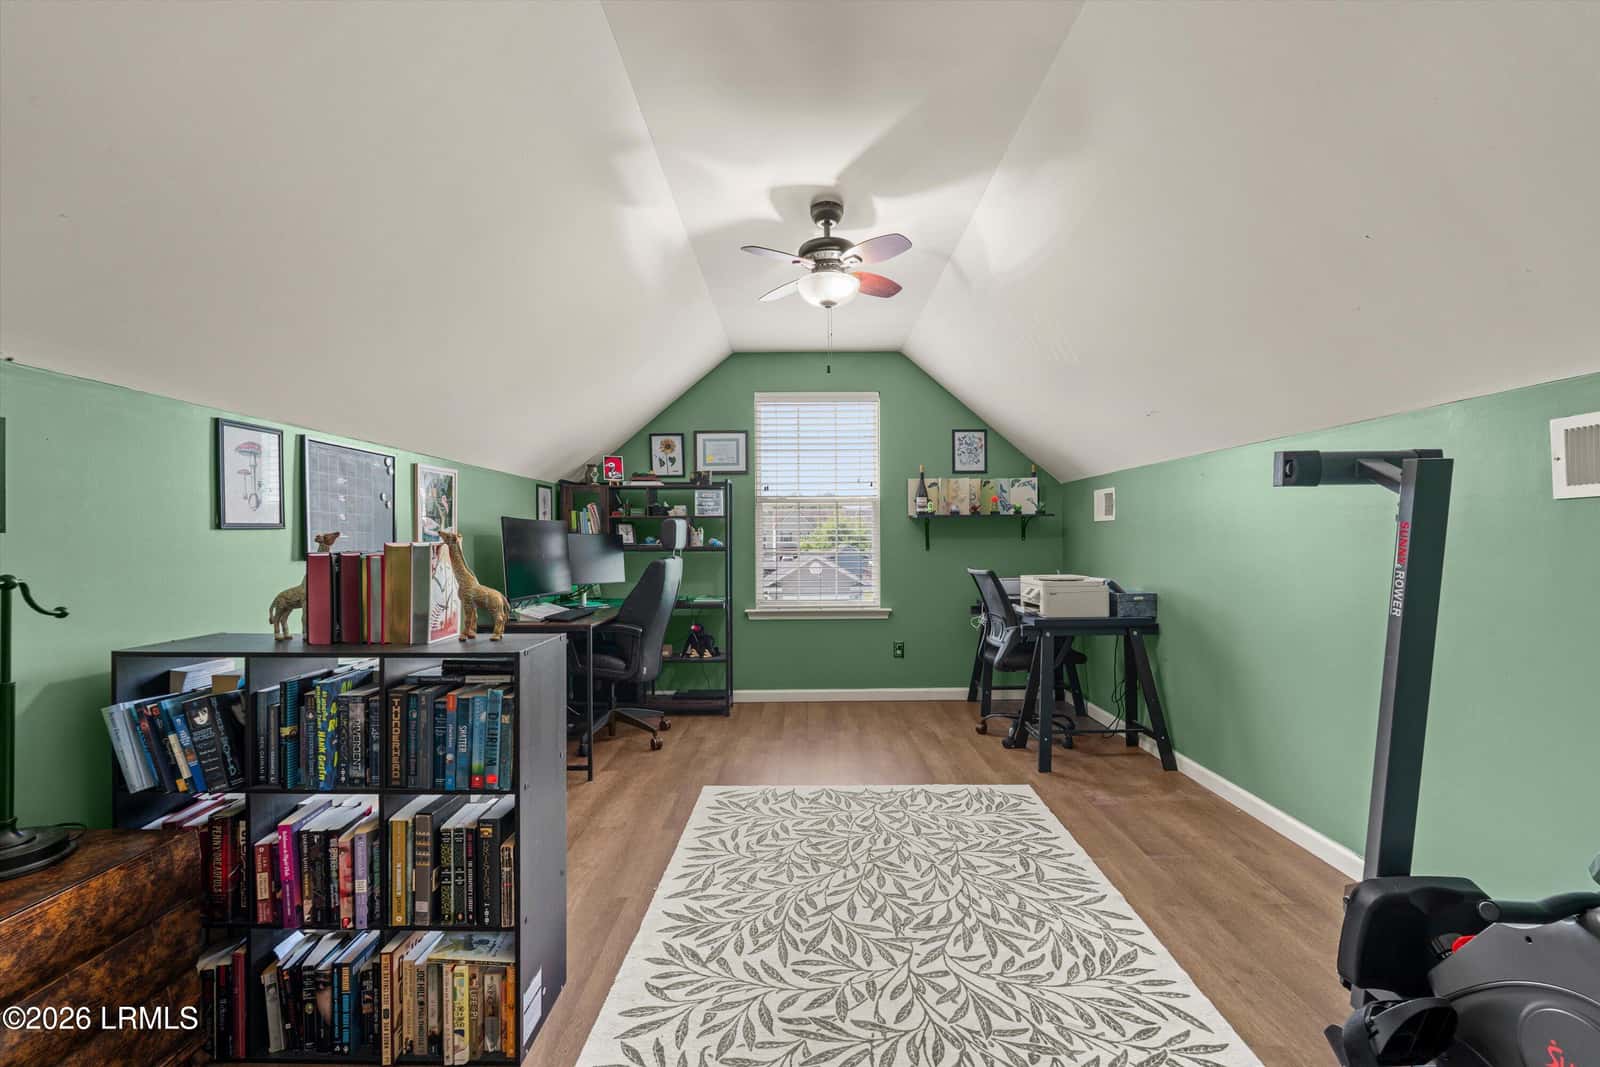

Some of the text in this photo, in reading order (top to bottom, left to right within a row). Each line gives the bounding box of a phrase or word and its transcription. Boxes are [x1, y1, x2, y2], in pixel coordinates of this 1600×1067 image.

[1392, 570, 1405, 616] ROWER
[317, 731, 327, 753] HANK
[352, 719, 361, 771] DIVERGENT
[458, 725, 468, 752] SHATTER
[416, 968, 425, 982] JOE
[416, 984, 425, 999] HILL
